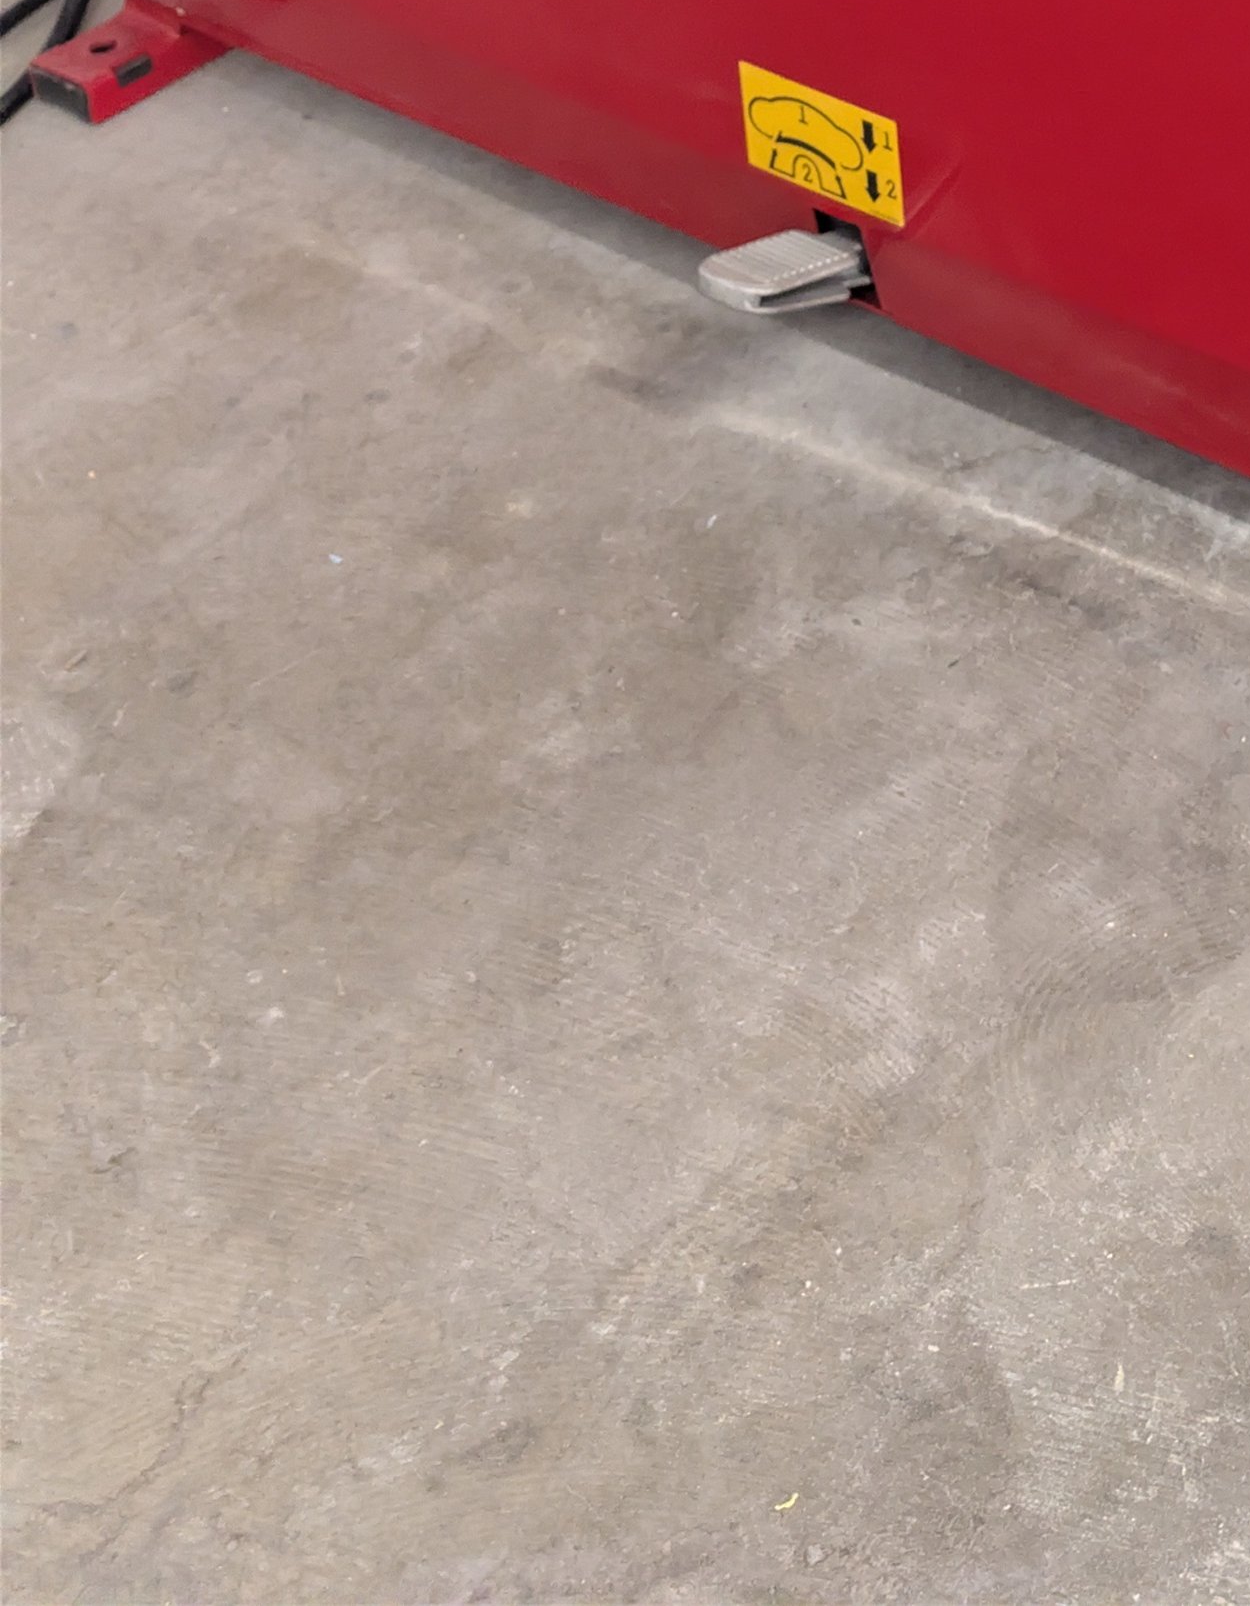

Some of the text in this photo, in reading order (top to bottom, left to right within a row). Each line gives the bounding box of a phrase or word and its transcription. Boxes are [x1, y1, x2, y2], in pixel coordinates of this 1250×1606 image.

[798, 105, 809, 125] 1
[882, 131, 893, 151] 1
[802, 163, 813, 183] 2
[886, 180, 897, 199] 2
